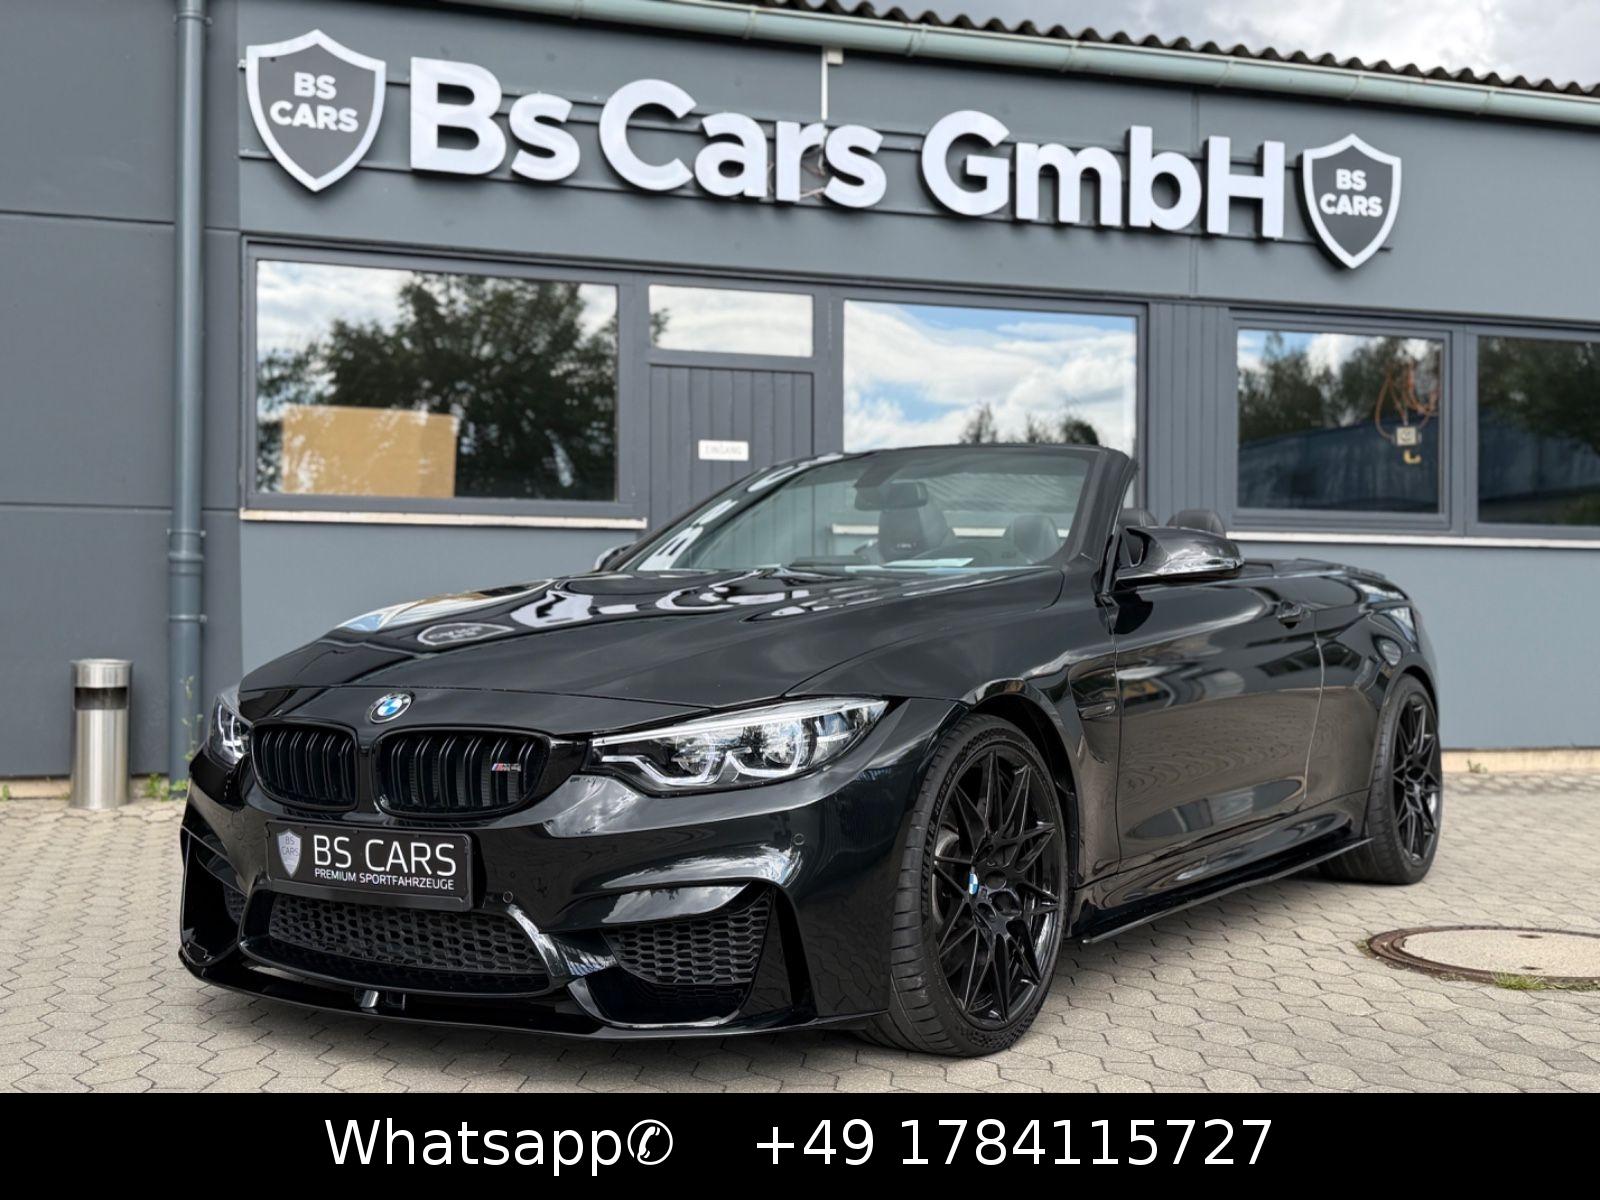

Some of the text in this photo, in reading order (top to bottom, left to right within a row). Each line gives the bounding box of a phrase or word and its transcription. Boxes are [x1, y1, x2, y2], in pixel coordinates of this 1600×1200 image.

[294, 71, 337, 100] BS
[269, 100, 359, 132] CARS
[410, 56, 1286, 239] Bs Cars GmbH
[1336, 168, 1367, 191] BS
[1320, 193, 1383, 217] CARS
[313, 834, 457, 876] BS CARS
[314, 867, 455, 890] PREMIUM SPORTFAHRZEUGE
